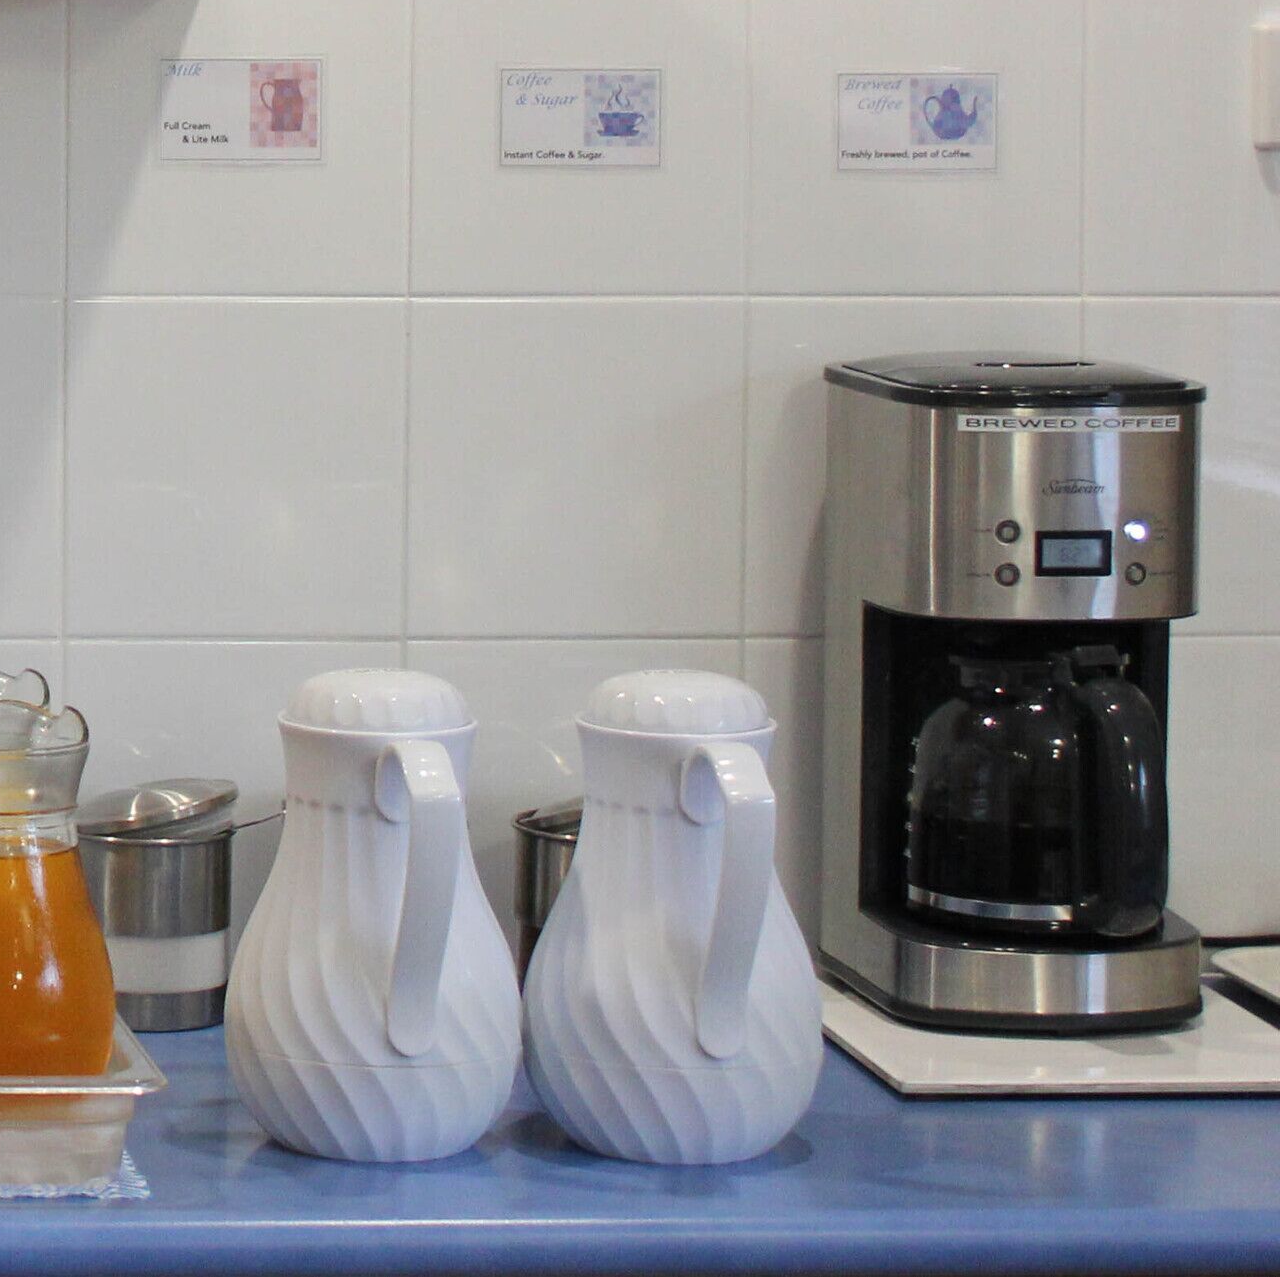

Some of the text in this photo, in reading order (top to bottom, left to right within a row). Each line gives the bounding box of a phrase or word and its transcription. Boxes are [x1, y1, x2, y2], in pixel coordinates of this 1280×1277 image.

[506, 72, 552, 88] Coffee
[844, 79, 903, 90] Brewed
[515, 93, 578, 109] & Sugar
[857, 96, 904, 113] Coffee
[164, 122, 211, 130] Full Cream
[182, 135, 229, 143] & Lite Milk
[504, 151, 533, 159] Instant
[536, 151, 566, 159] Coffee
[568, 151, 575, 159] &
[841, 150, 872, 160] Freshly
[912, 150, 928, 159] pot
[930, 150, 940, 158] of
[966, 417, 1177, 429] BREWED COFFEE
